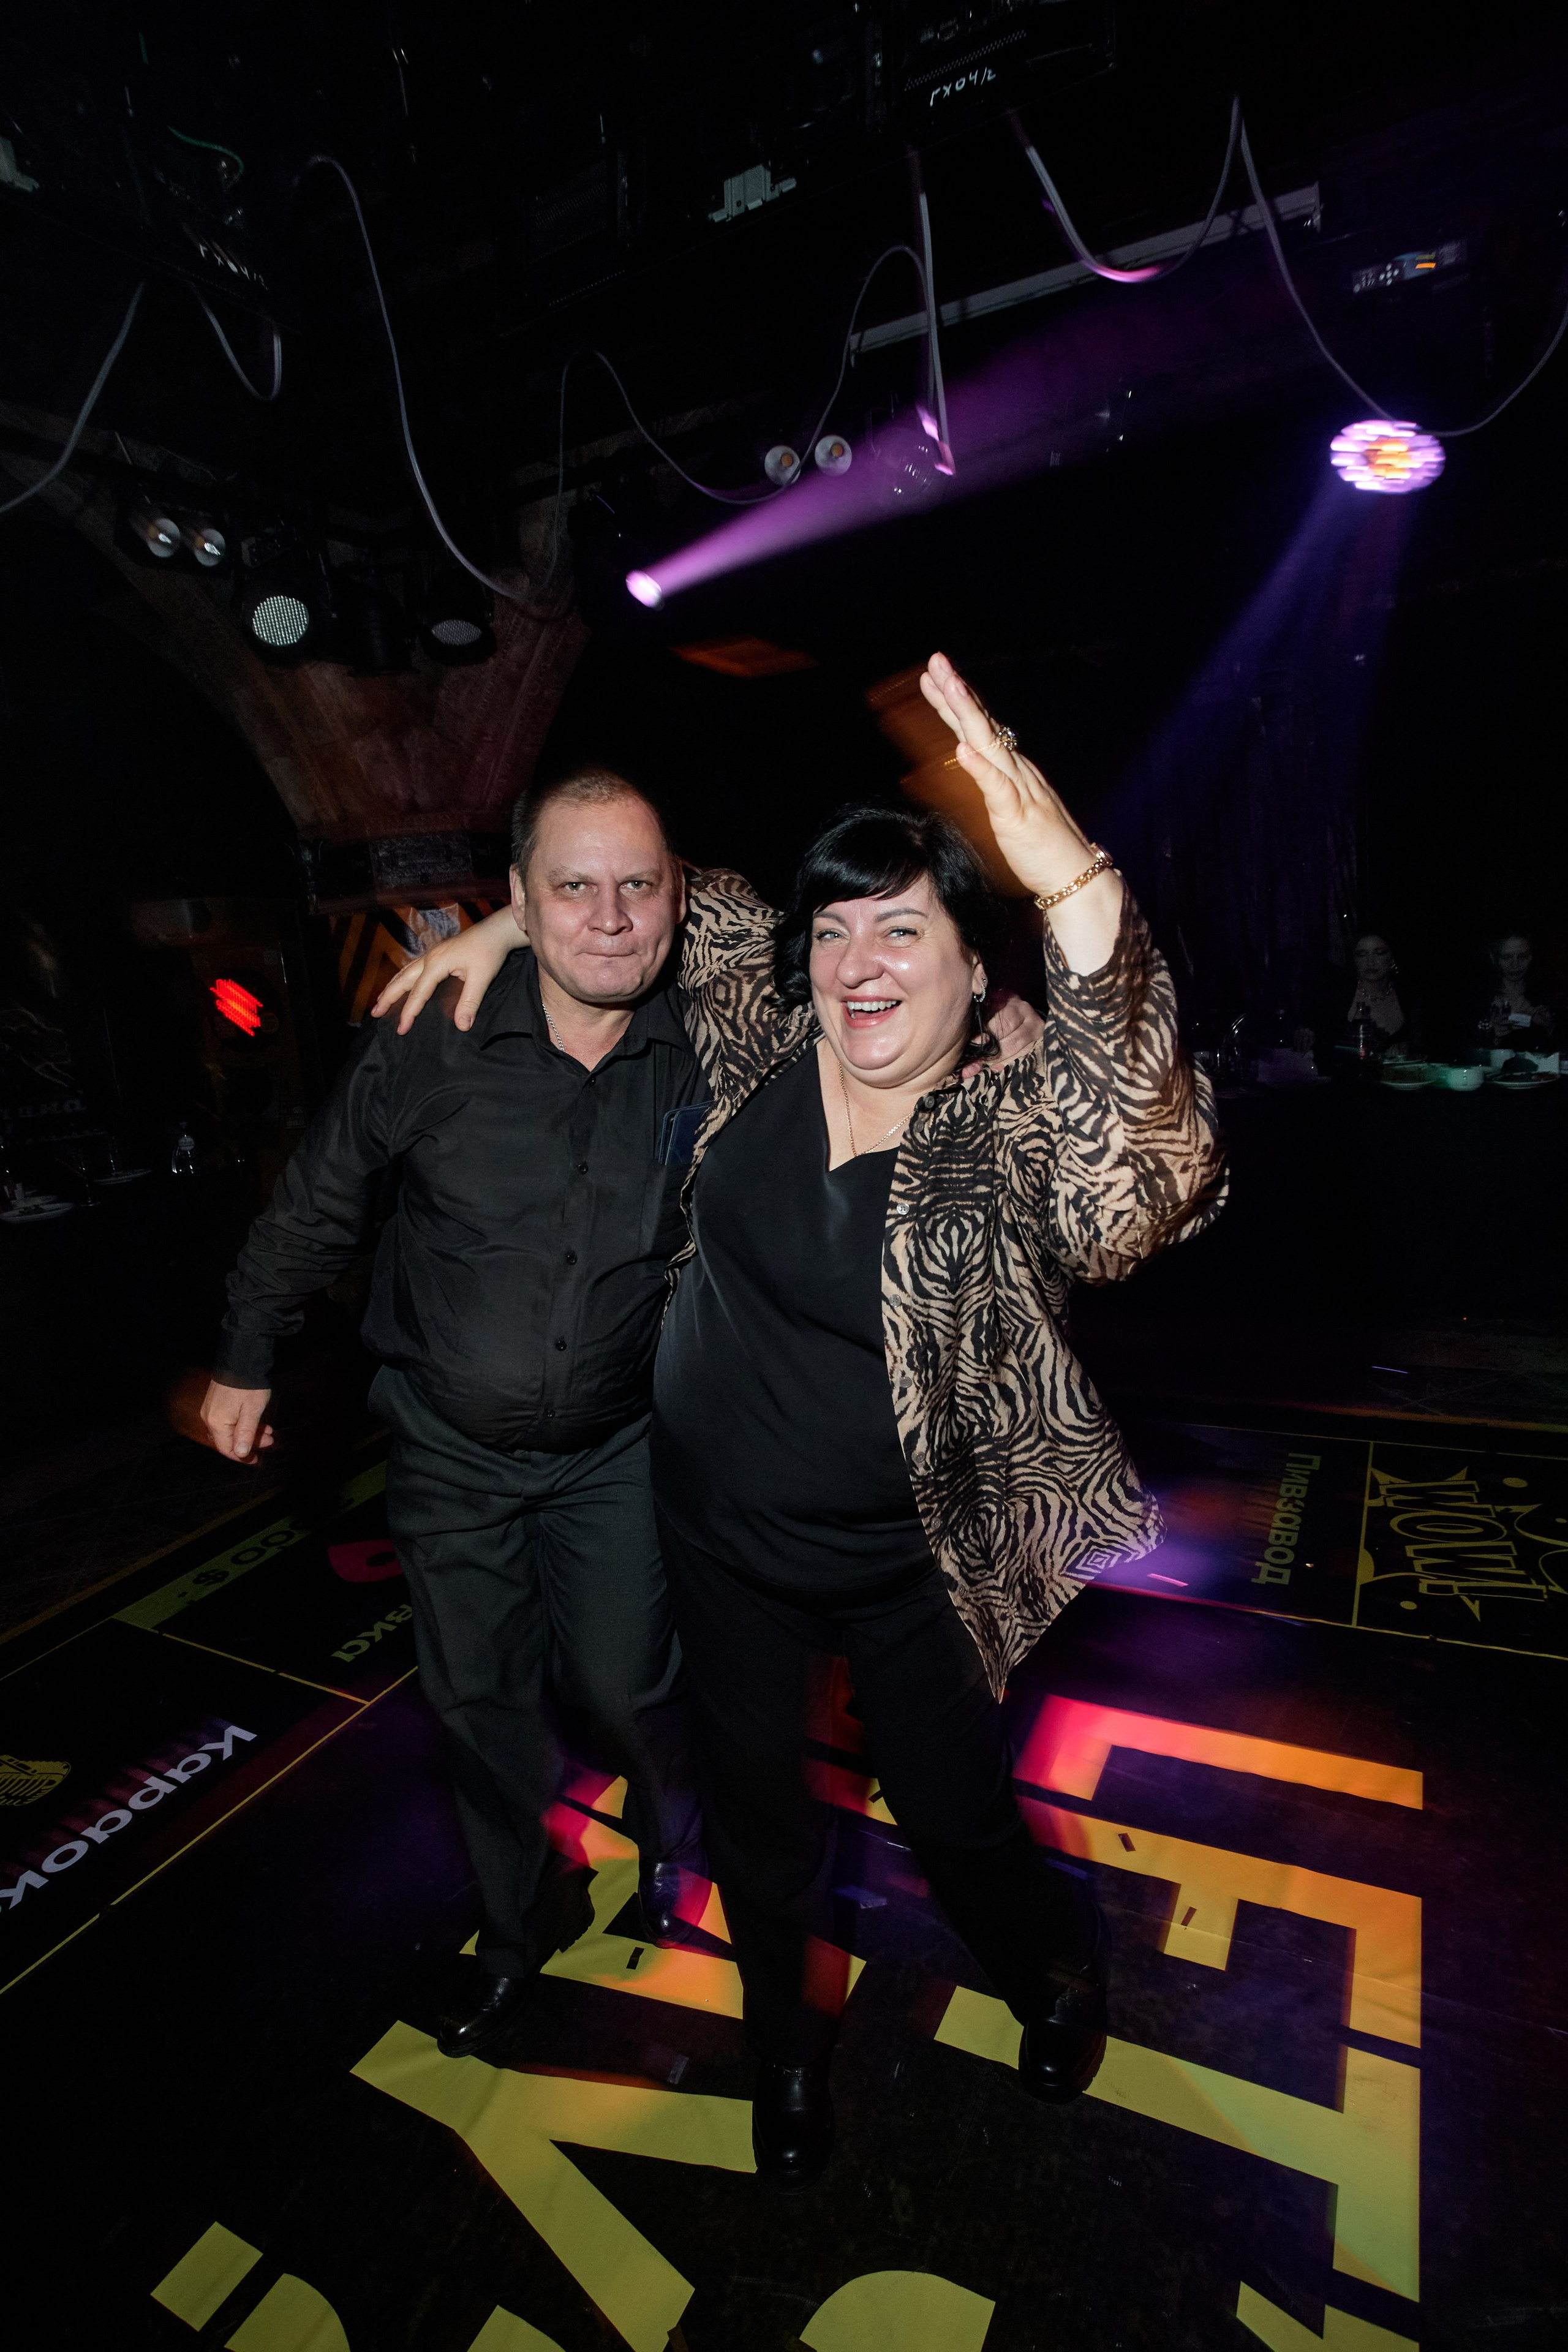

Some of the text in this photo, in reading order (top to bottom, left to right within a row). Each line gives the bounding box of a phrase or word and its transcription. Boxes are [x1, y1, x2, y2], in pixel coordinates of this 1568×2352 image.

[1250, 1452, 1323, 1586] Пивзавод
[1378, 1479, 1548, 1603] WOW!
[0, 1725, 258, 1911] Караок
